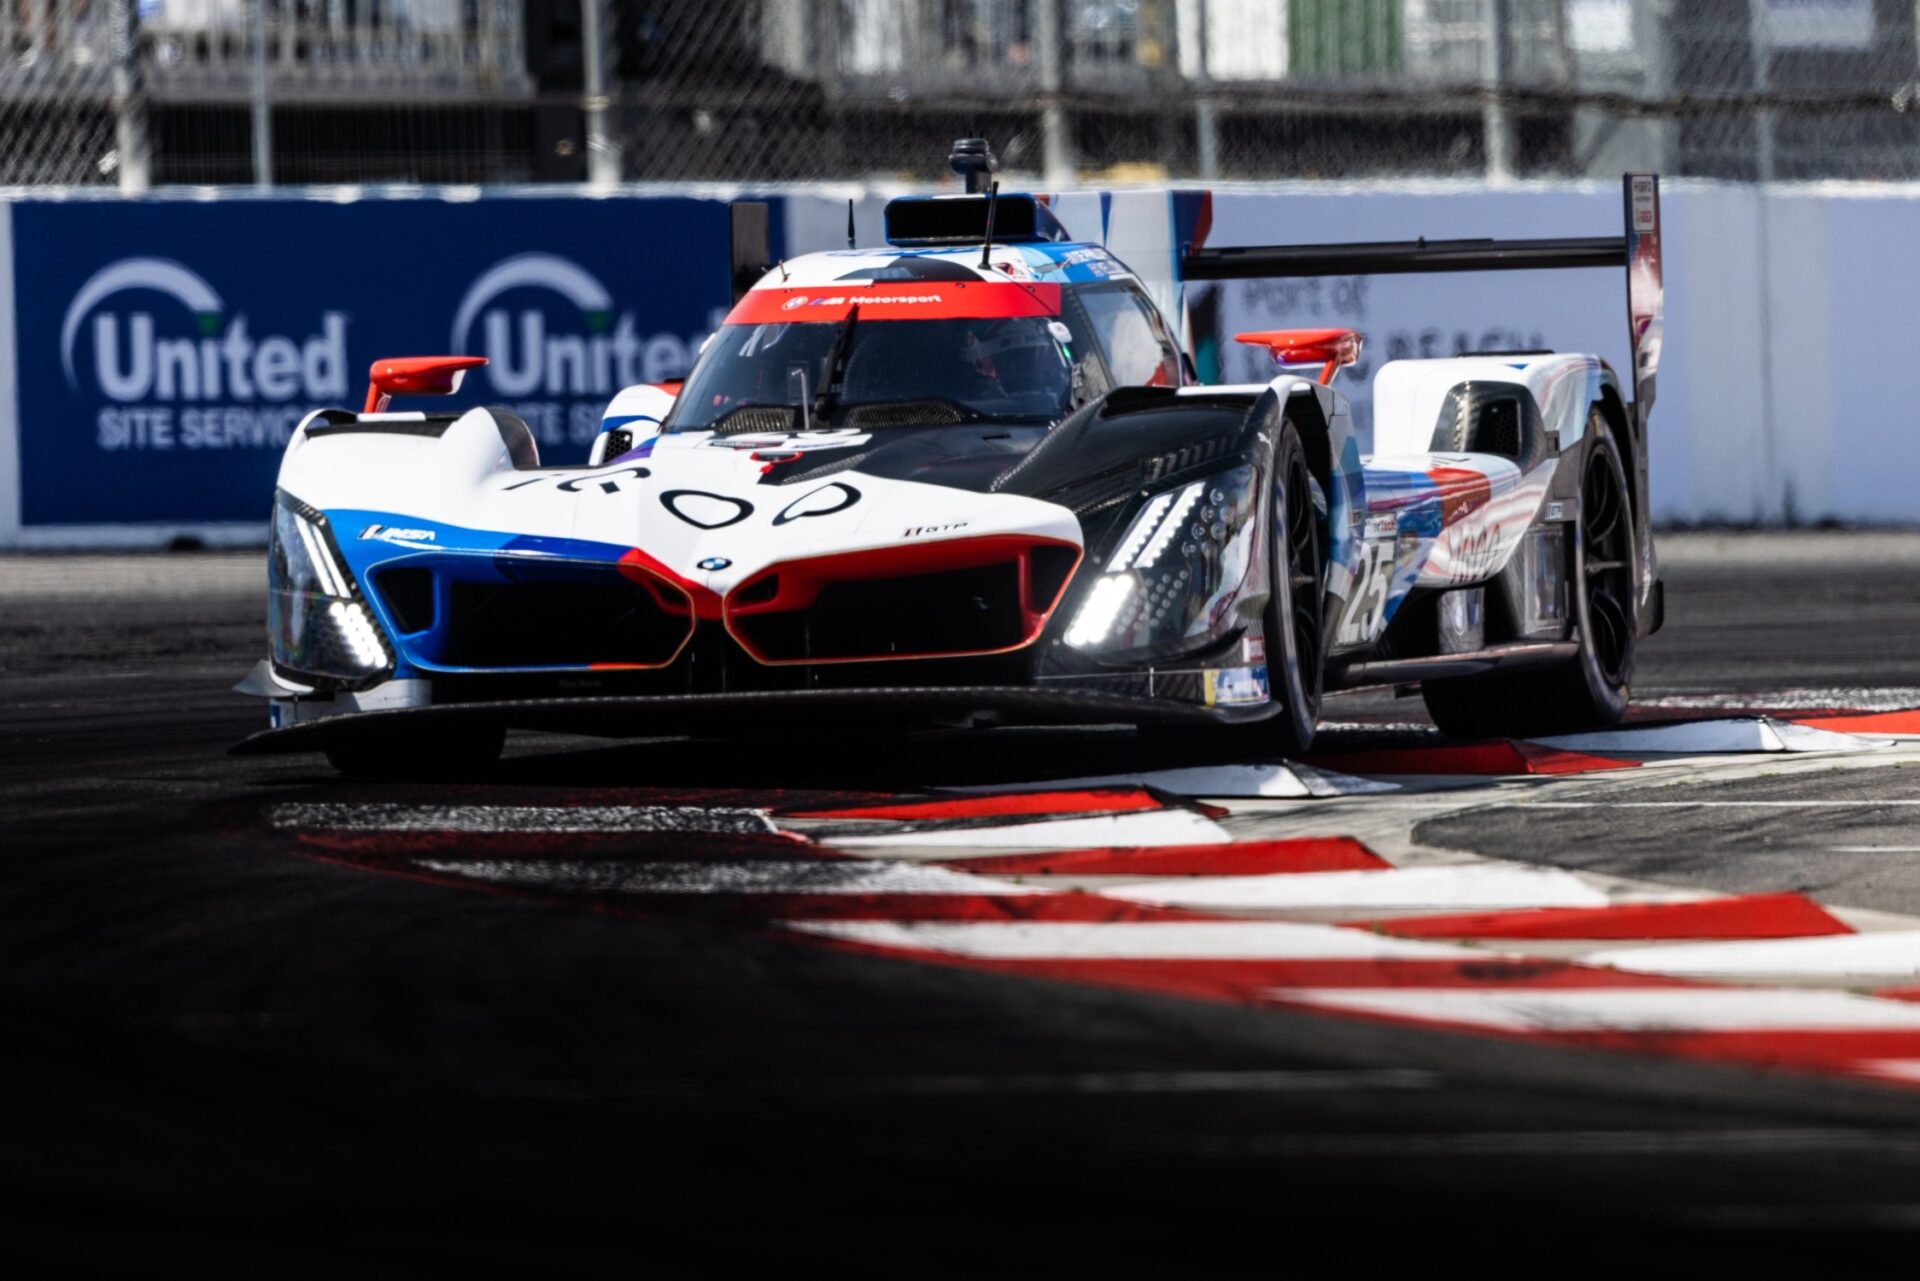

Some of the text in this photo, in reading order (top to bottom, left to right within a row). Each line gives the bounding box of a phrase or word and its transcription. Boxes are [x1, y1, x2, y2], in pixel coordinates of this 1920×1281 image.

[849, 294, 942, 304] Motorsport
[95, 311, 349, 401] United
[485, 307, 728, 395] Unite
[98, 406, 308, 449] SITE SERVIC
[1335, 542, 1396, 646] 25
